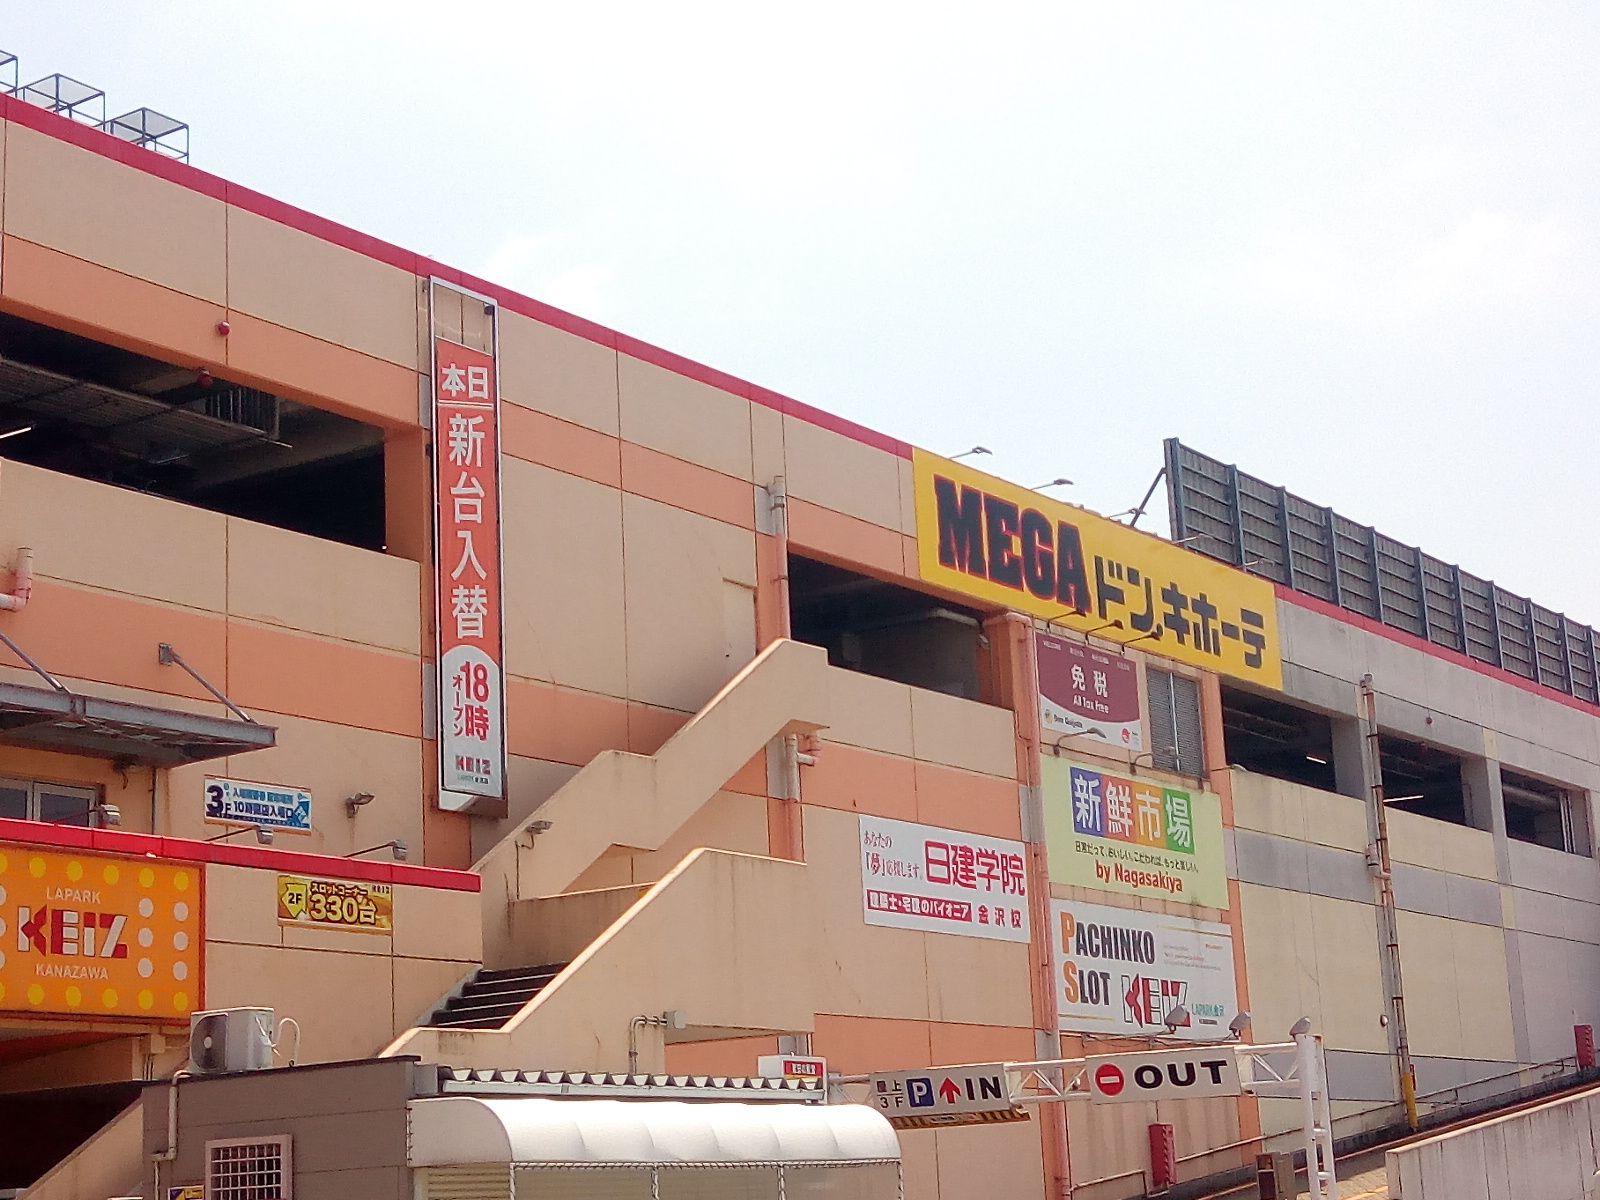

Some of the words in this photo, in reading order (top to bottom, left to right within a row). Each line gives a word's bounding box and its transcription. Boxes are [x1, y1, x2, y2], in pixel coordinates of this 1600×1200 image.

[441, 363, 489, 400] 本日
[449, 413, 487, 639] 新台入替
[933, 473, 1092, 613] MEGA
[1071, 664, 1108, 698] 免税
[452, 674, 464, 738] オープン
[1074, 773, 1191, 848] 新鮮市場
[864, 830, 893, 849] あなたの
[925, 840, 1026, 897] 日建学院
[1095, 860, 1110, 884] by
[1114, 862, 1183, 894] Nagasakiya
[47, 886, 101, 904] LAPARK
[288, 893, 303, 905] 2F
[309, 893, 377, 925] 330台
[1060, 911, 1155, 965] PACHINKO
[36, 963, 109, 980] KANAZAWA
[1063, 960, 1111, 1006] SLOT
[965, 1076, 1002, 1101] IN
[1134, 1060, 1228, 1089] OUT
